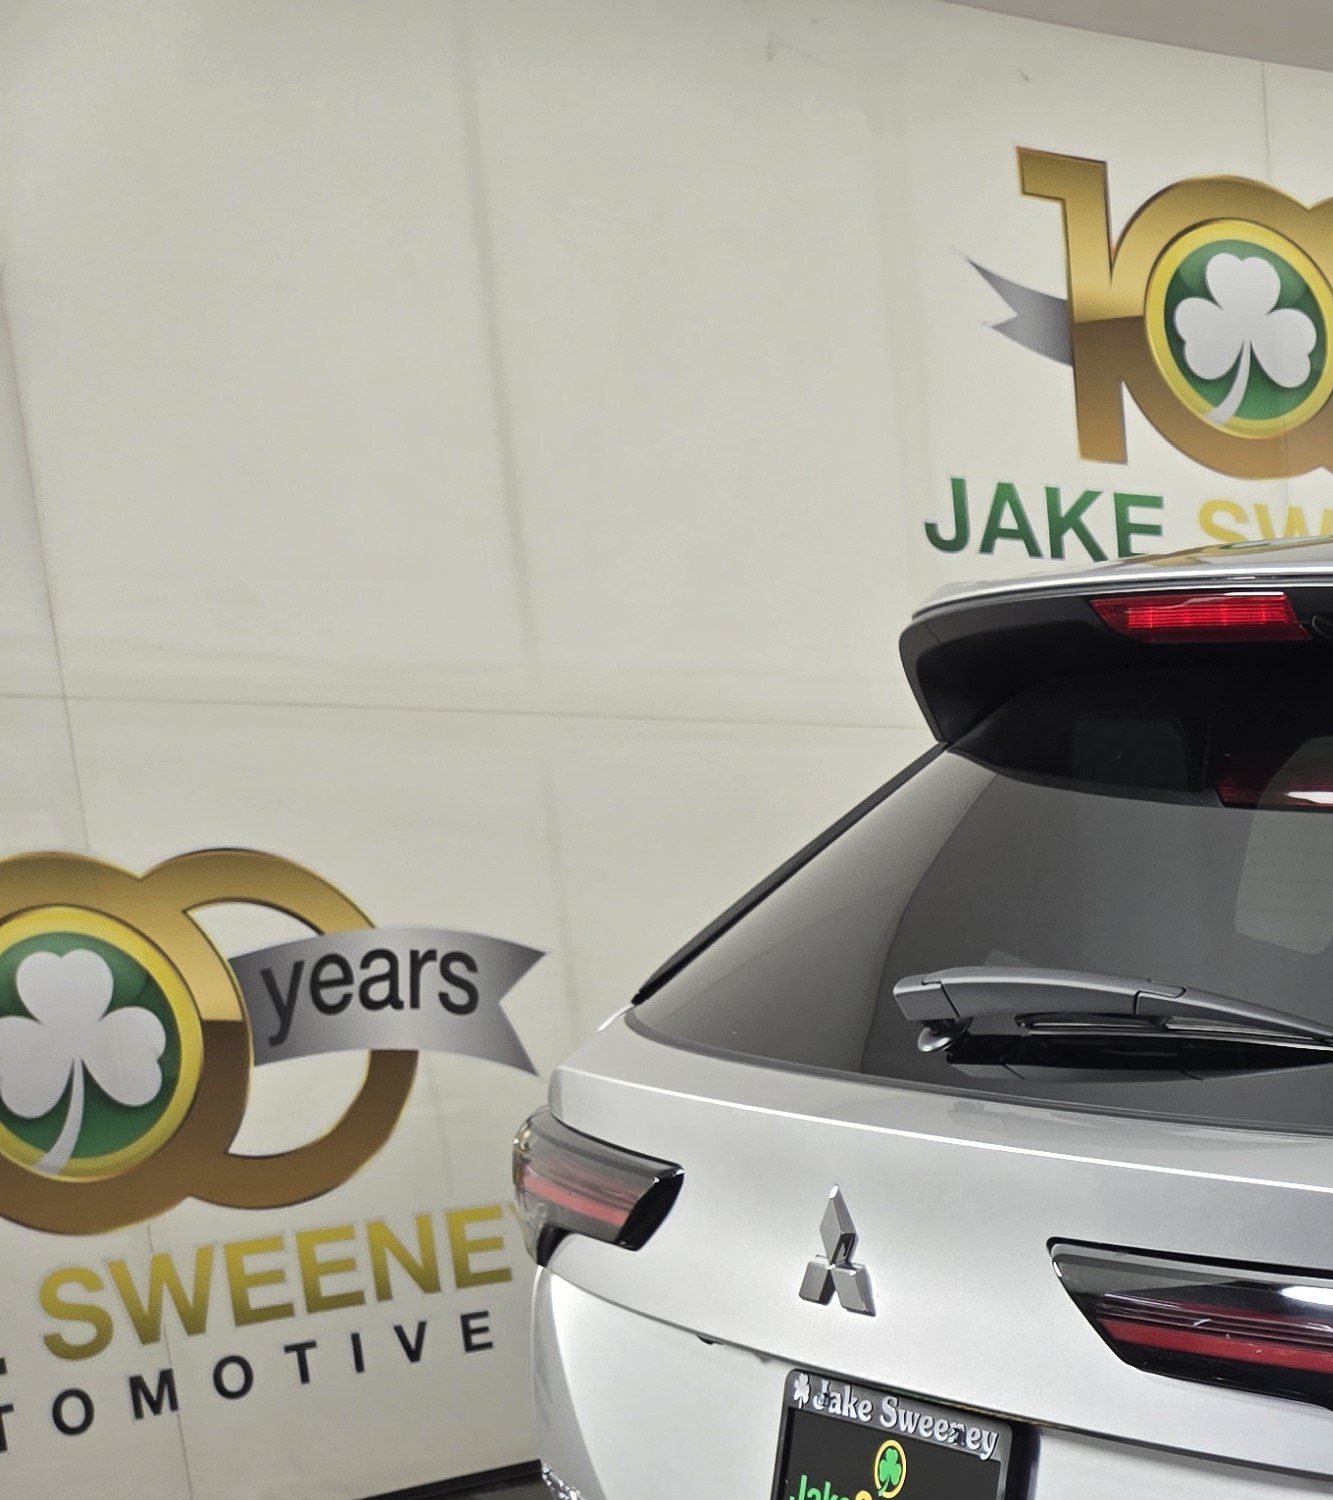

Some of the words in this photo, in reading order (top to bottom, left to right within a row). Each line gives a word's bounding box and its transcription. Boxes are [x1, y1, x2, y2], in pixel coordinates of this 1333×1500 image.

[924, 476, 1164, 563] JAKE
[258, 945, 481, 1048] years
[38, 1201, 524, 1362] SWEENE
[813, 1379, 872, 1422] Jake
[879, 1396, 999, 1461] Sweeney
